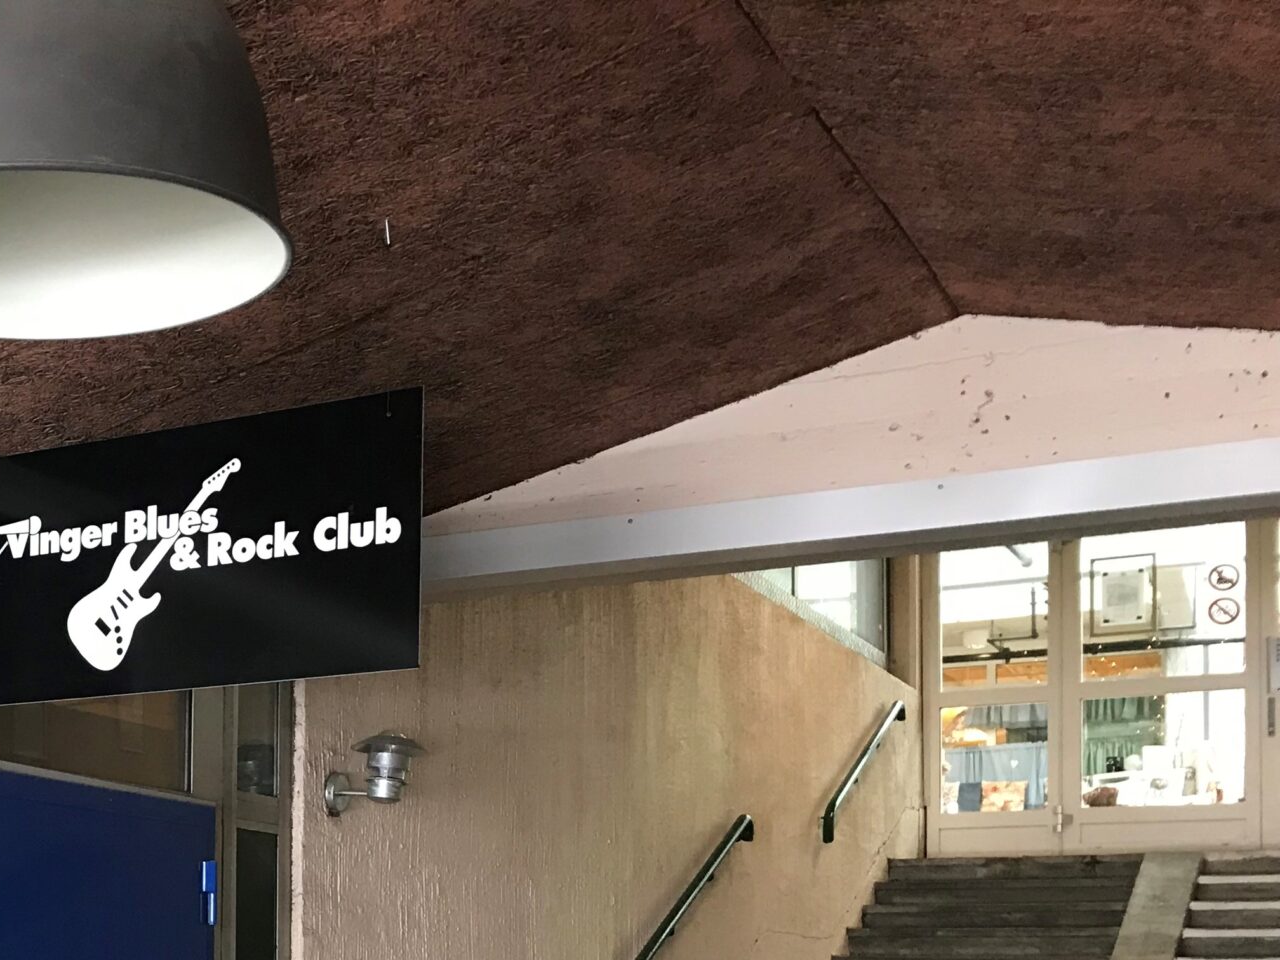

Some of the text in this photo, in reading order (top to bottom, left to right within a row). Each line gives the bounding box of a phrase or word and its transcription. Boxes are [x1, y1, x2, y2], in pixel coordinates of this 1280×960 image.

[0, 505, 218, 563] Vinger Blues
[169, 506, 402, 571] & Rock Club
